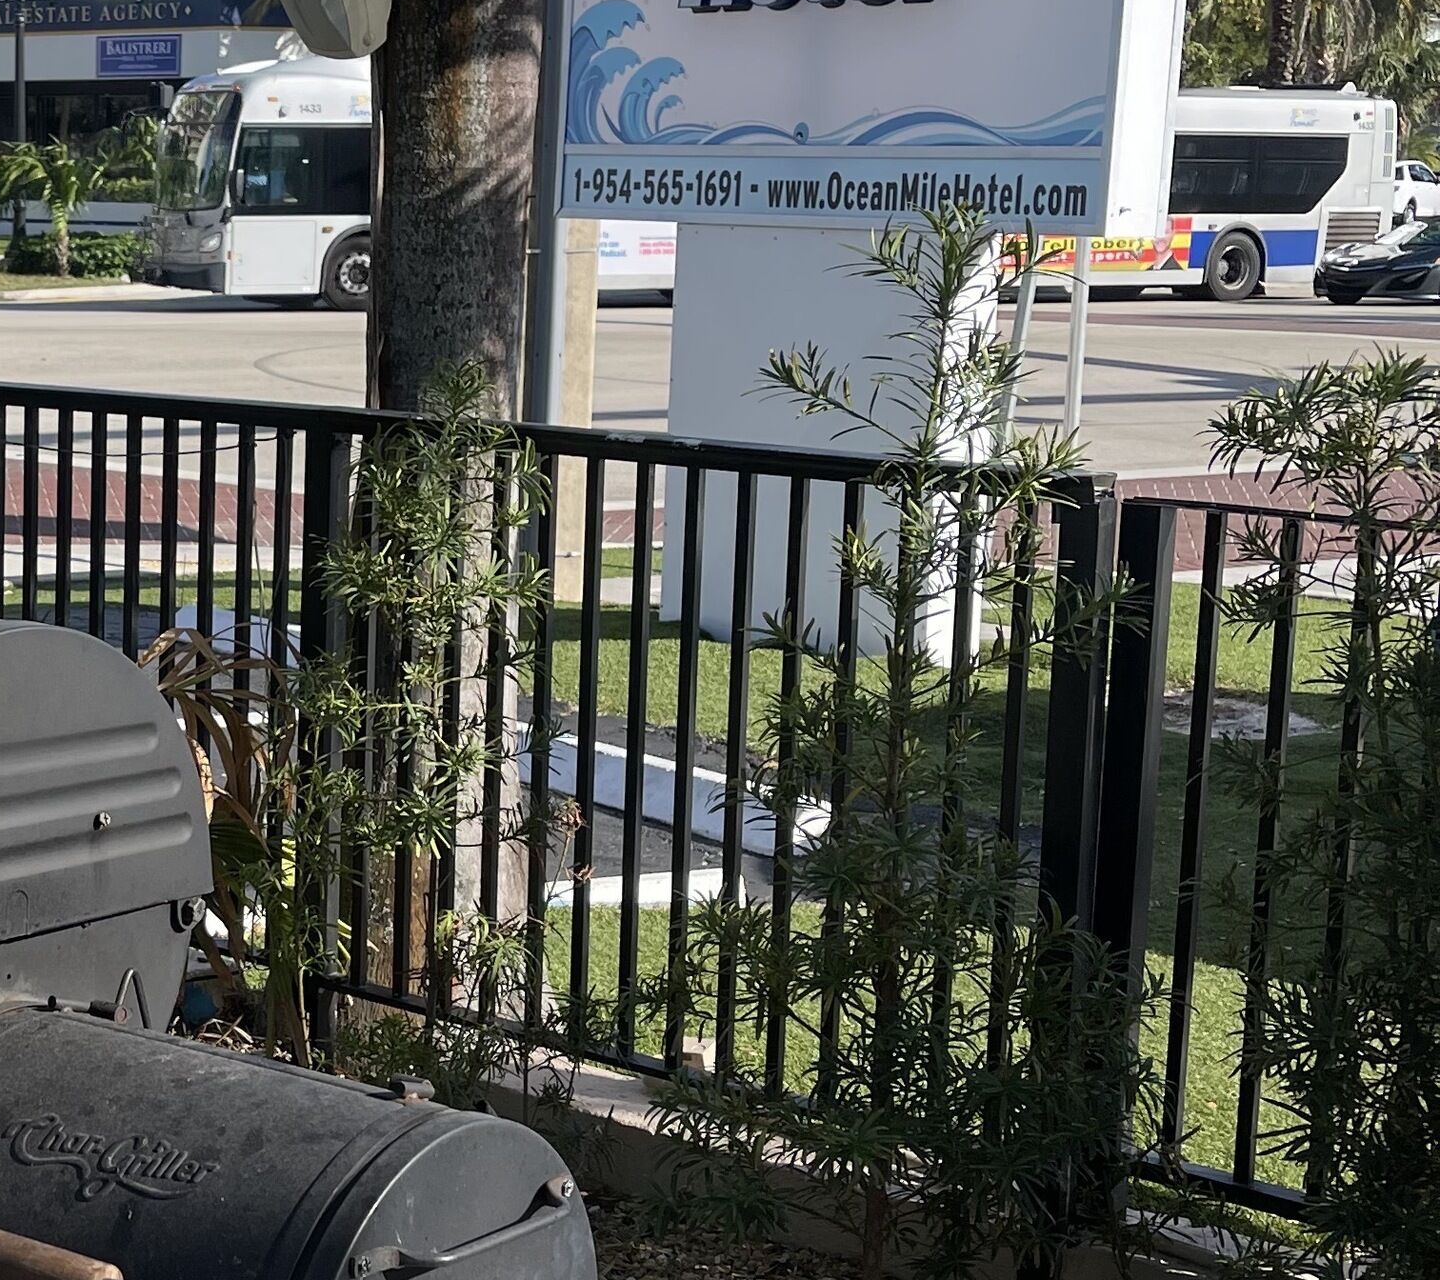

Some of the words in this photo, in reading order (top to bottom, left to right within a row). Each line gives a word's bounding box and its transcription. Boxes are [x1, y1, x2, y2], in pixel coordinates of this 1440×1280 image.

[23, 6, 92, 24] ESTATE
[99, 1, 181, 22] AGENCY
[299, 104, 322, 114] 1433
[574, 167, 742, 207] 1-954-565-1691
[767, 171, 1088, 217] www.OceanMileHotel.com
